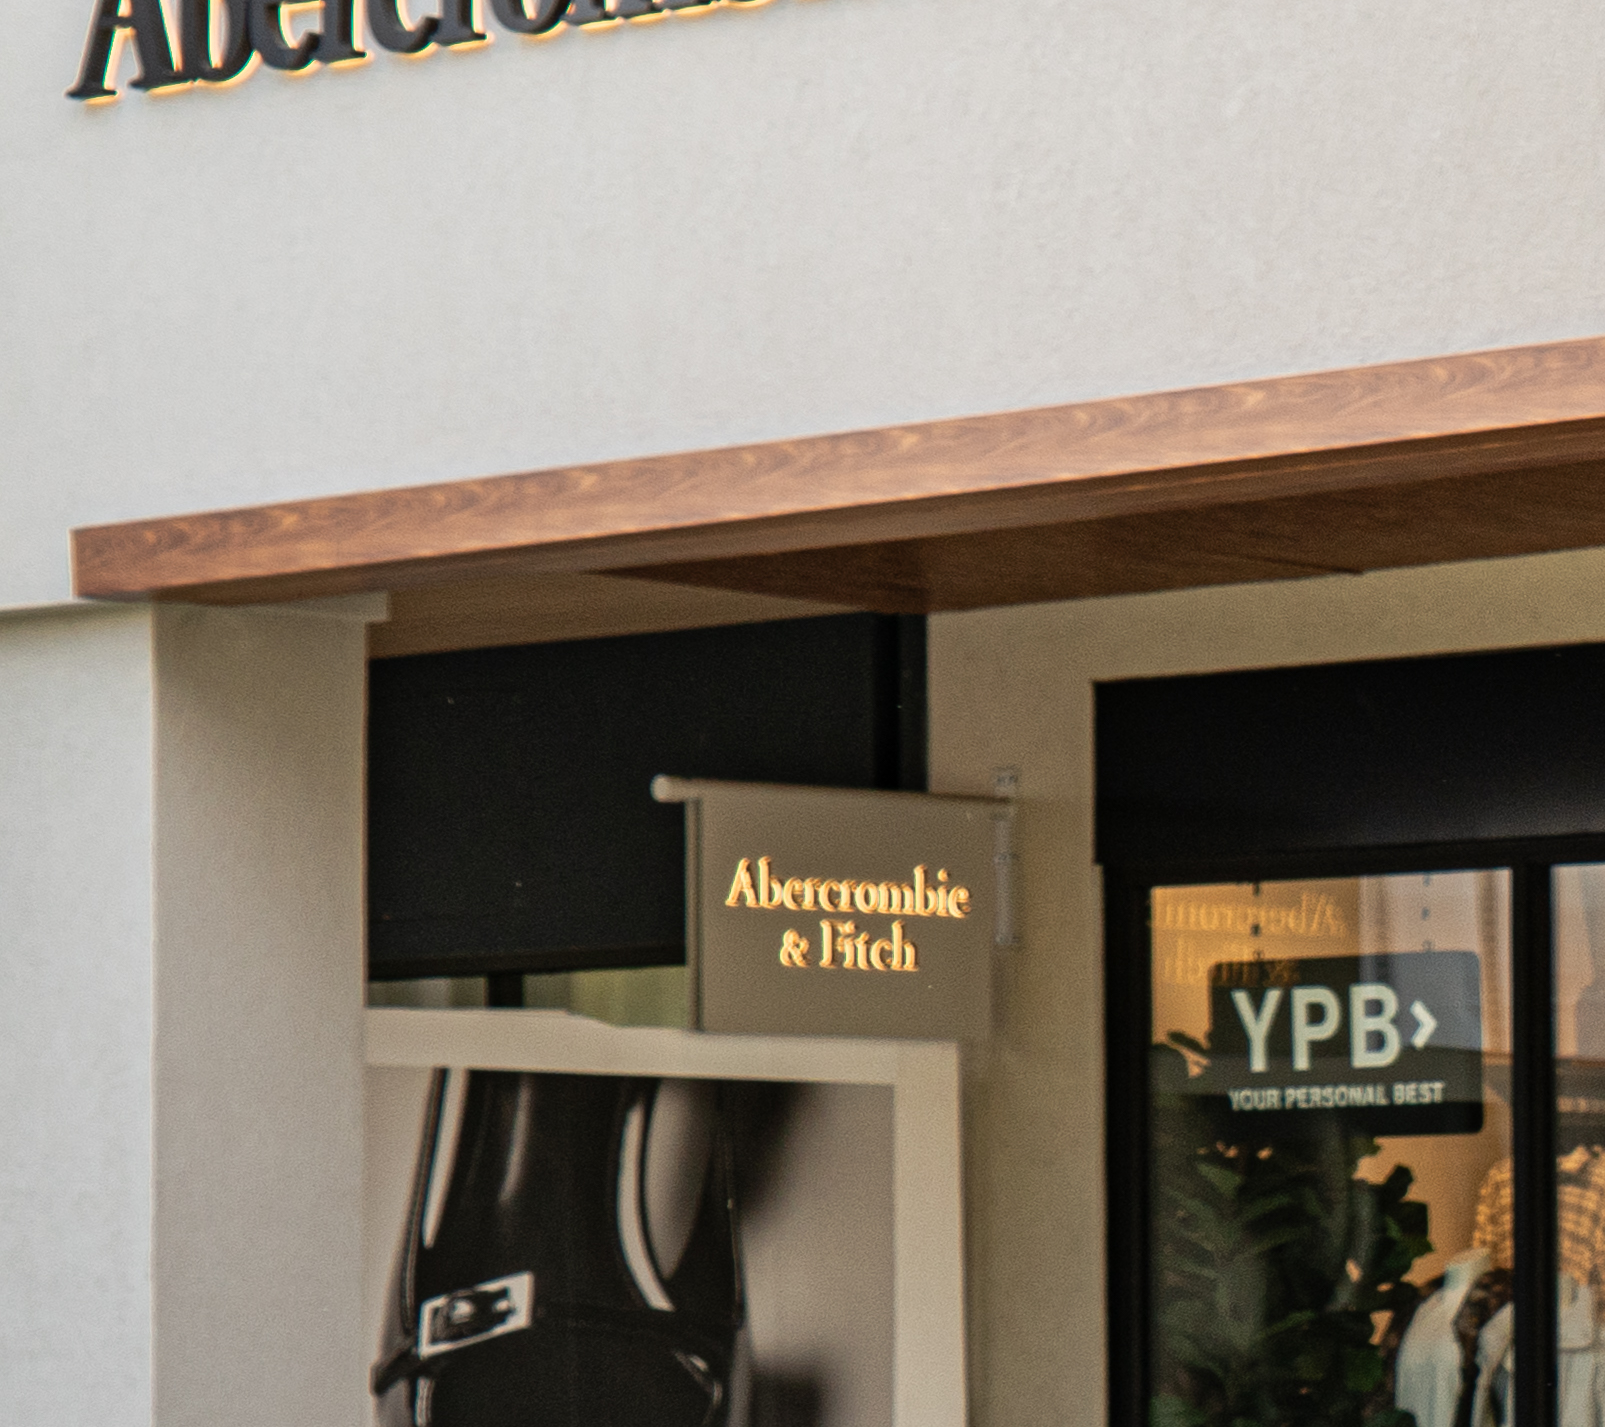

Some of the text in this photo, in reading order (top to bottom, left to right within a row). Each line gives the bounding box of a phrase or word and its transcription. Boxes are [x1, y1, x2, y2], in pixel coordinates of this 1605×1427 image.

[725, 856, 971, 918] Abercrombie
[779, 919, 919, 971] & Fitch
[1230, 981, 1402, 1073] YPB
[1228, 1080, 1446, 1111] YOUR PERSONAL BEST
